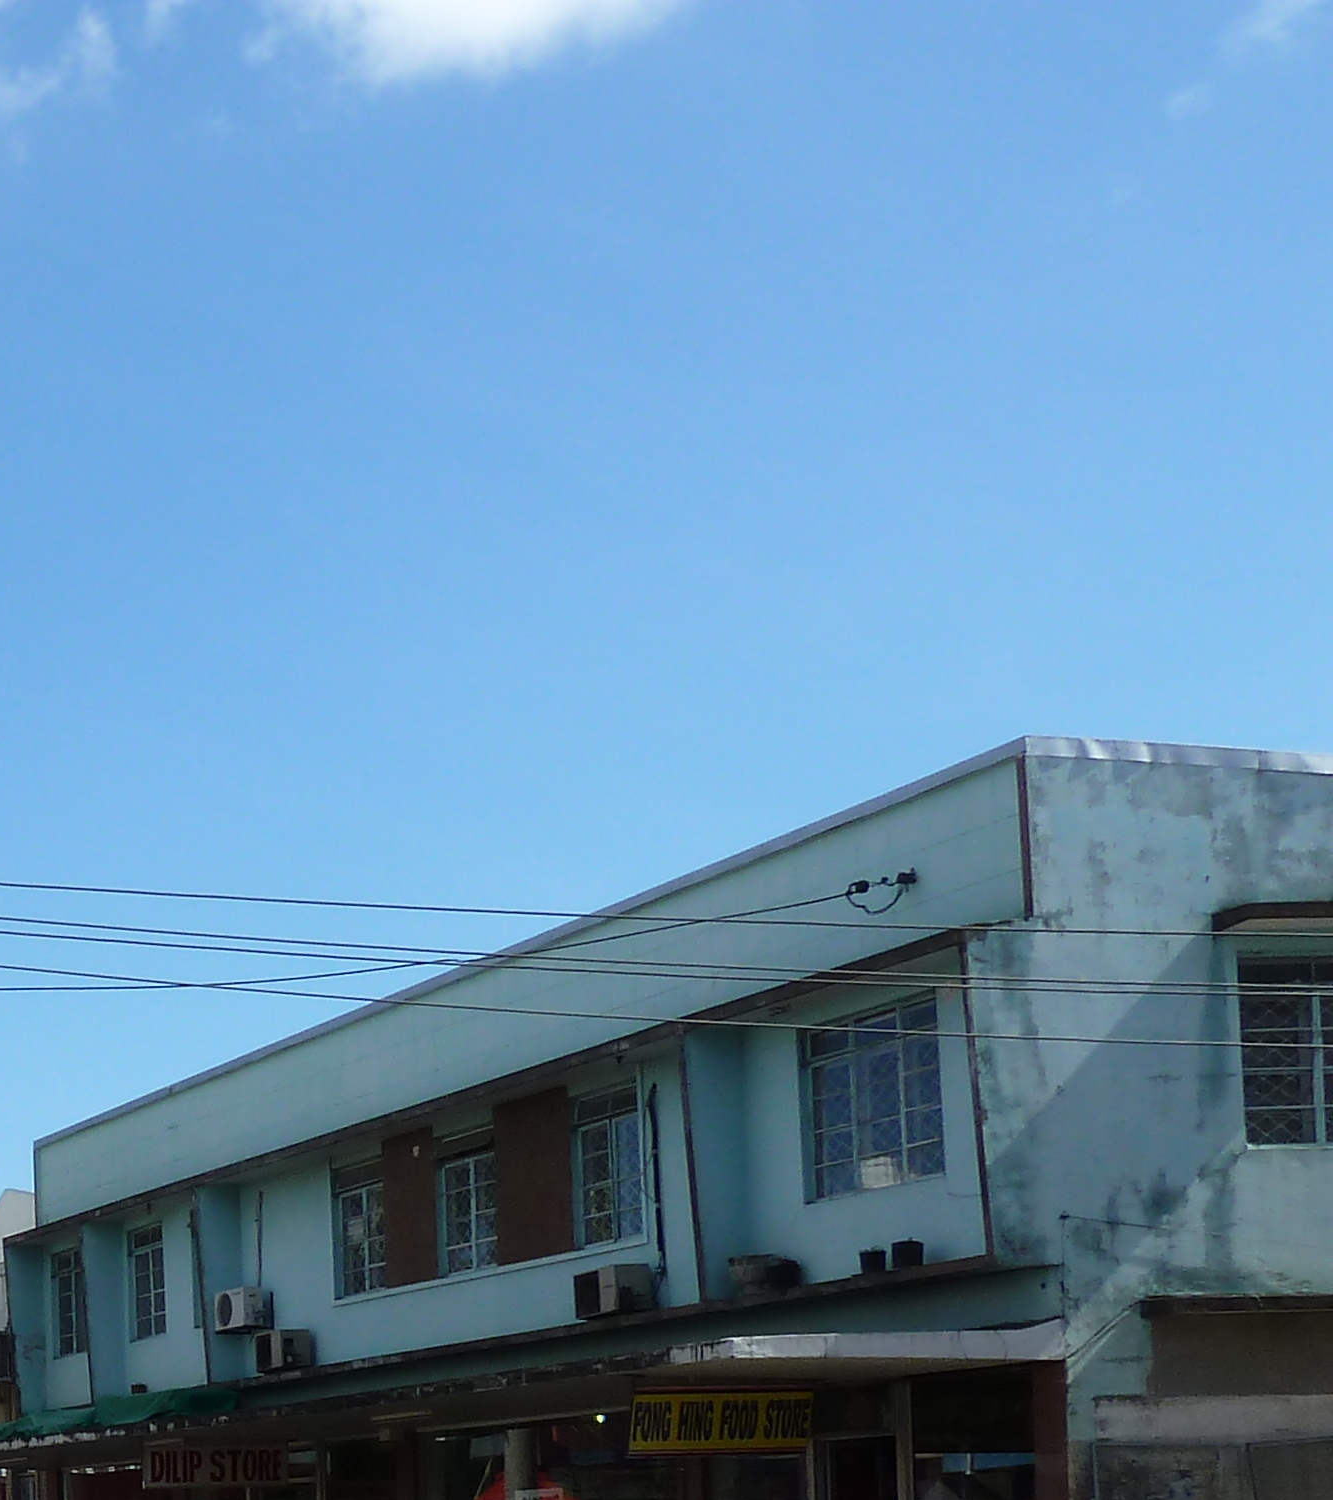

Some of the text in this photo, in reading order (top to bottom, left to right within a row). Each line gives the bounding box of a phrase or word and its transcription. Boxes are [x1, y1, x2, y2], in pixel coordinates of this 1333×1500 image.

[633, 1398, 811, 1442] FONG HING FOOD STORE
[151, 1449, 281, 1483] DILIP STORE
